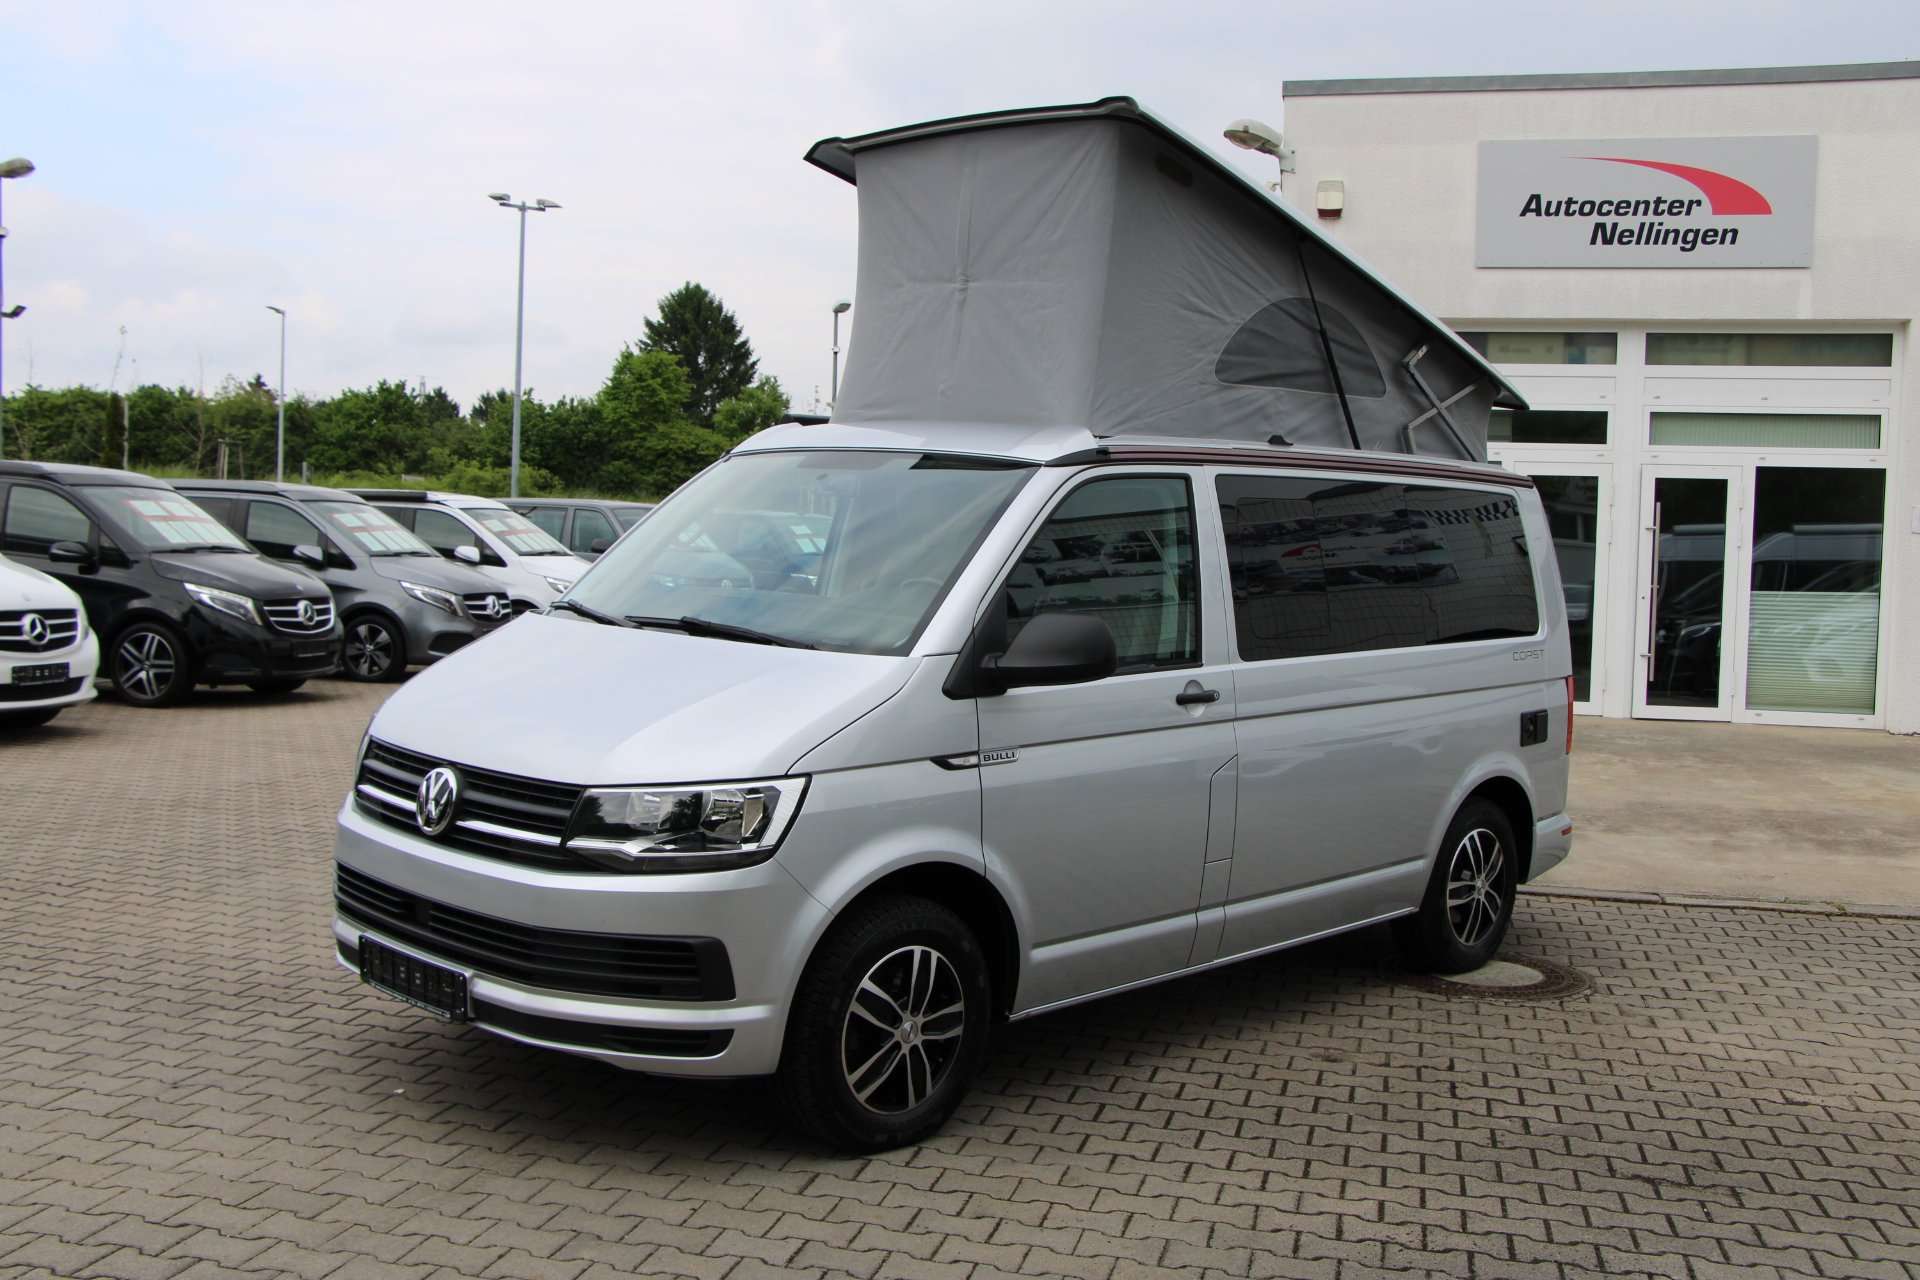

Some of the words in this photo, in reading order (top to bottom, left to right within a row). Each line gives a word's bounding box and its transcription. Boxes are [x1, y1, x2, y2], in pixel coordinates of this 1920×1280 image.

[1519, 193, 1703, 218] Autocenter
[1589, 221, 1739, 252] Nellingen
[983, 751, 1015, 762] BULLI
